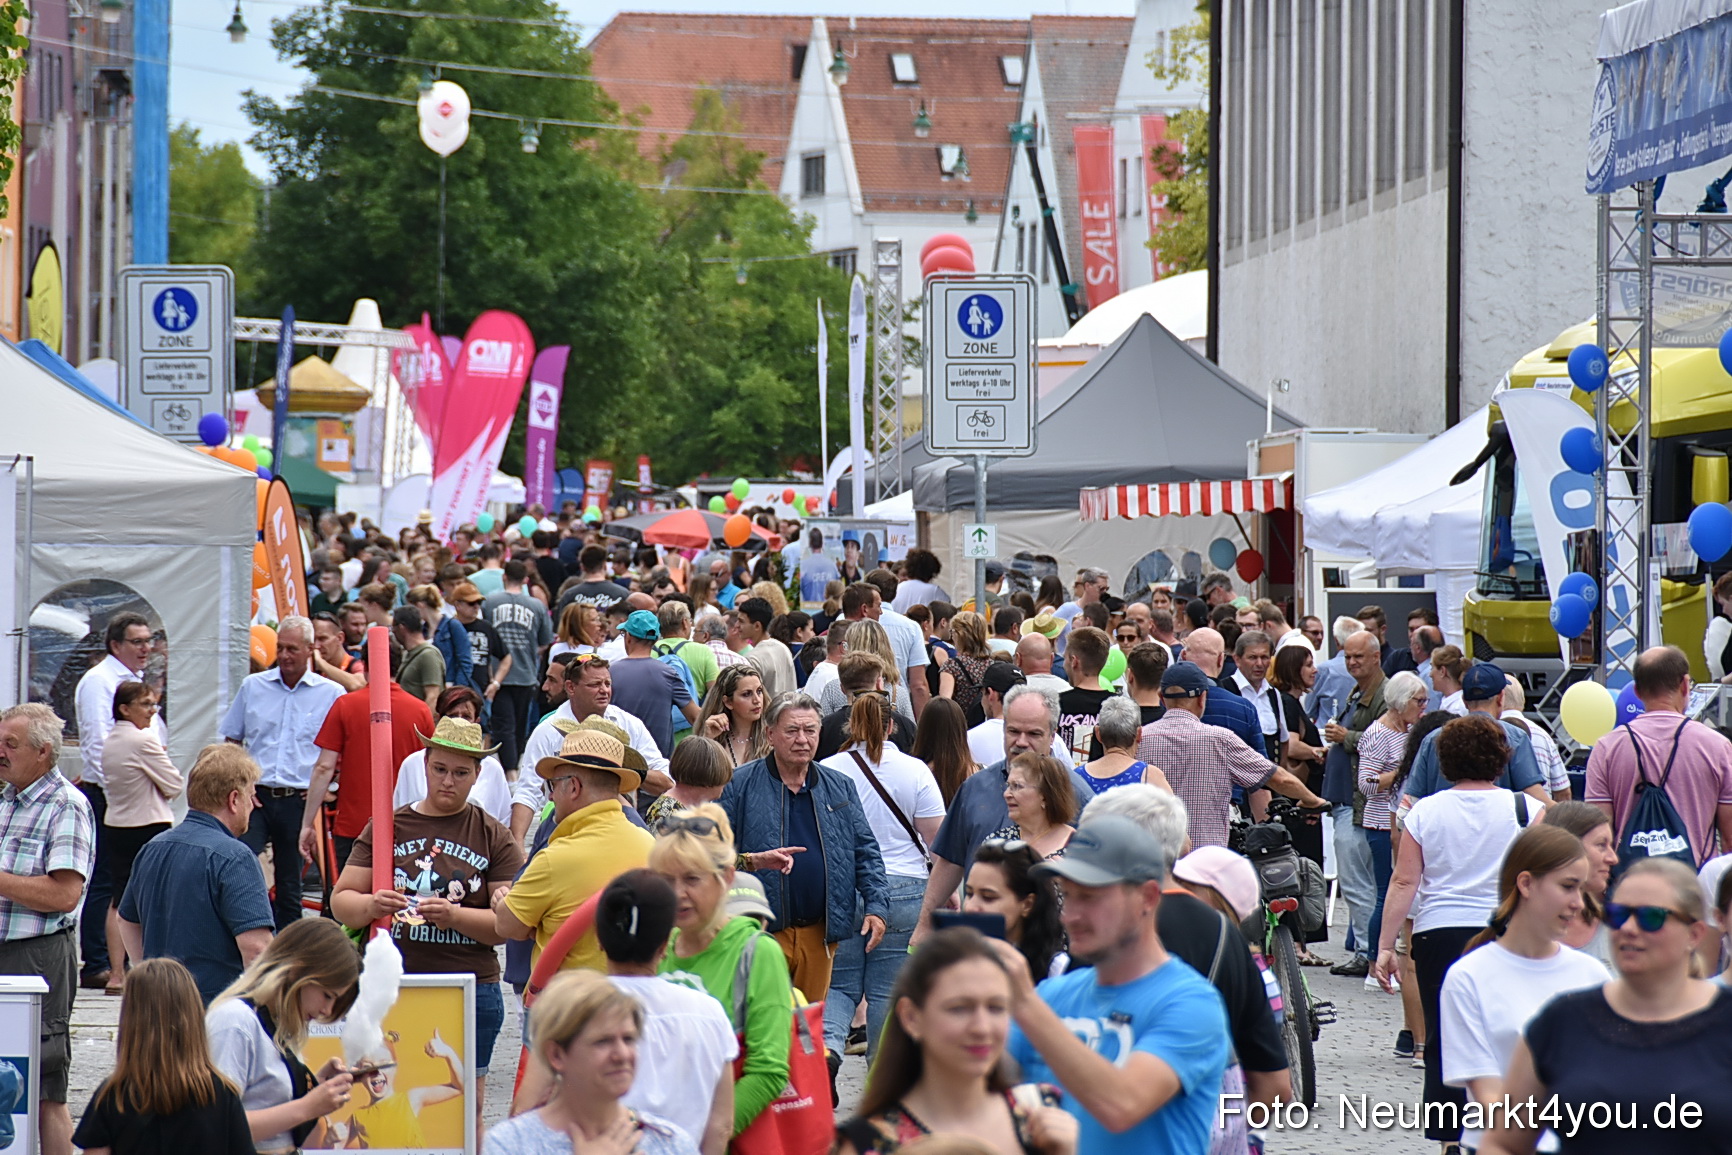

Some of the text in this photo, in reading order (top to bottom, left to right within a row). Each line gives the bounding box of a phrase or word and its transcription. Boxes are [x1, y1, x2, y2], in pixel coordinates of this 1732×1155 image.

[1083, 200, 1115, 286] SALE
[159, 335, 194, 348] ZONE
[963, 342, 998, 354] ZONE
[958, 367, 1002, 377] Lieferverkehr
[950, 378, 1012, 389] werktags 6-10 Uhr
[975, 388, 991, 397] frei
[973, 428, 989, 438] frei
[1059, 713, 1101, 728] LOS AN
[394, 838, 427, 858] NEY
